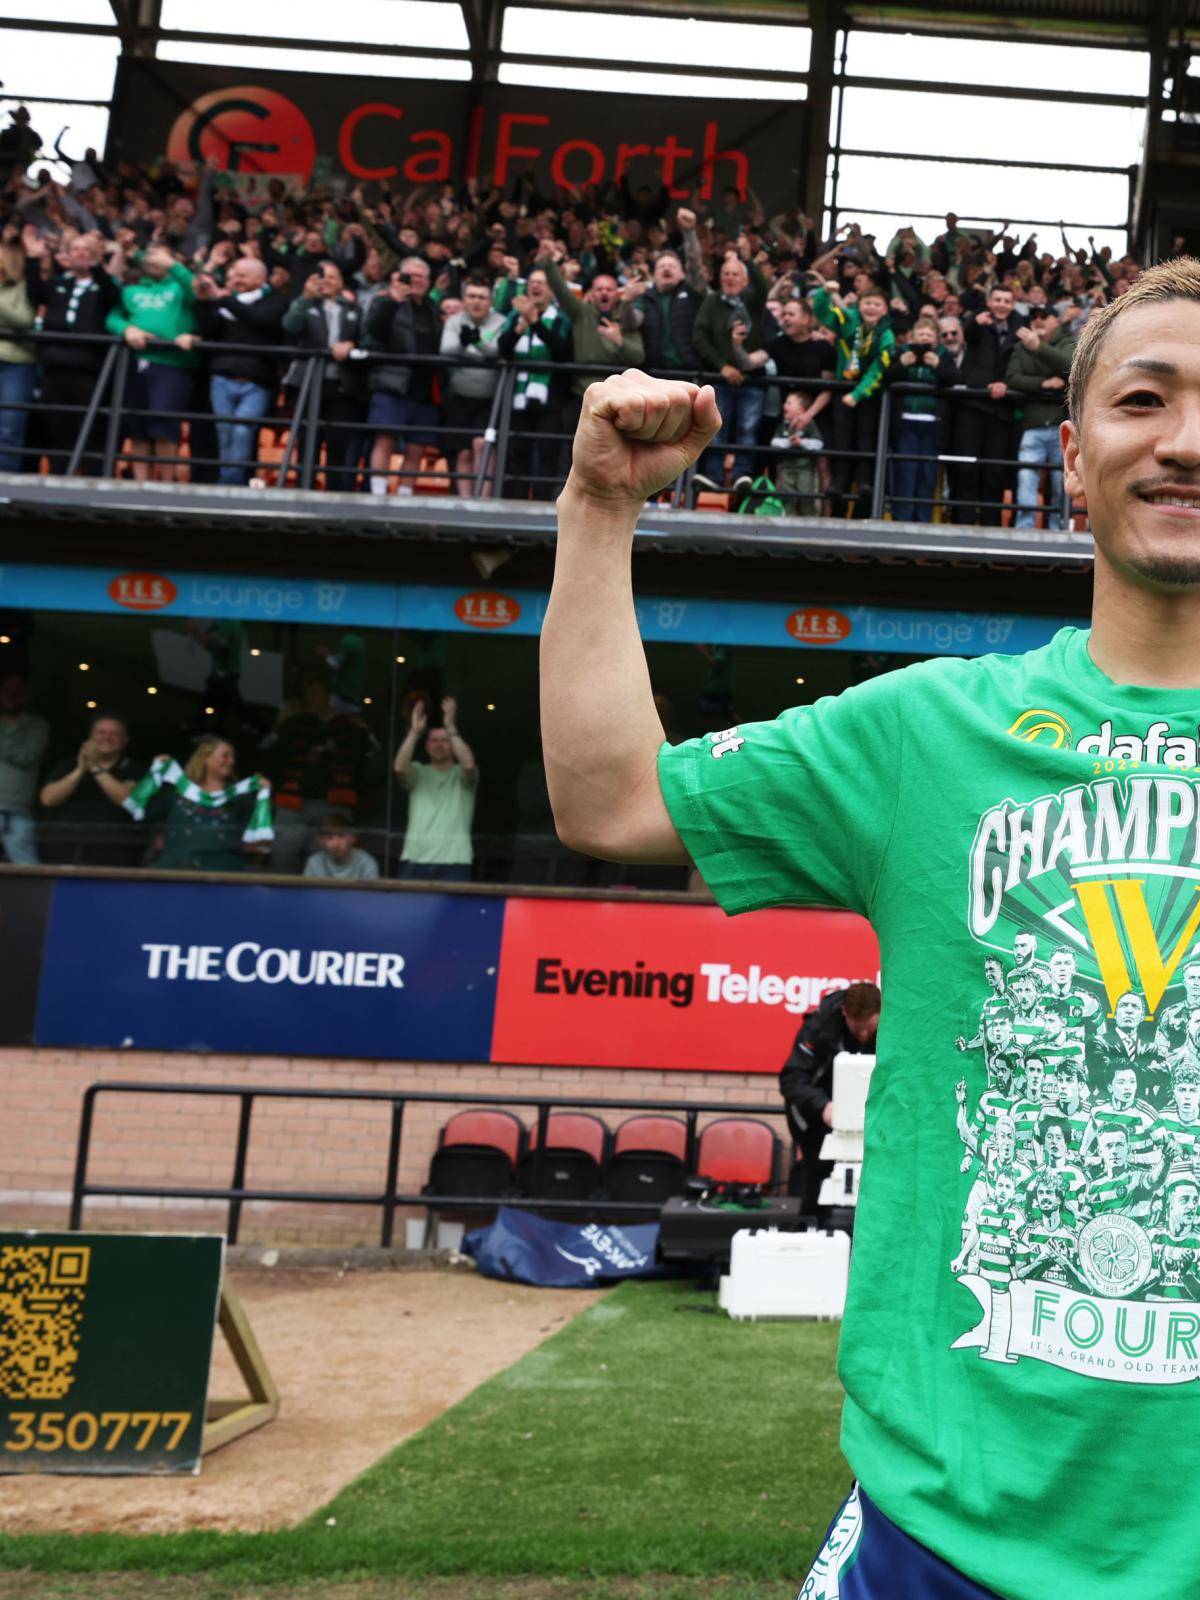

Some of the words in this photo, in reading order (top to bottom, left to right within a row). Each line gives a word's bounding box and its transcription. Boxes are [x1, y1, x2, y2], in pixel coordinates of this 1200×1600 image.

[338, 102, 750, 203] CalForth
[192, 580, 303, 615] Lounge
[866, 618, 971, 648] Lounge
[142, 943, 224, 982] THE
[225, 942, 405, 988] COURIER
[535, 958, 695, 1008] Evening
[701, 963, 881, 1014] Telegr
[1030, 1341, 1053, 1354] IT'S
[1057, 1348, 1065, 1357] A
[1070, 1351, 1116, 1368] GRAND
[1124, 1361, 1154, 1373] OLD
[1162, 1363, 1199, 1374] TEAM
[4, 1411, 193, 1451] 350777
